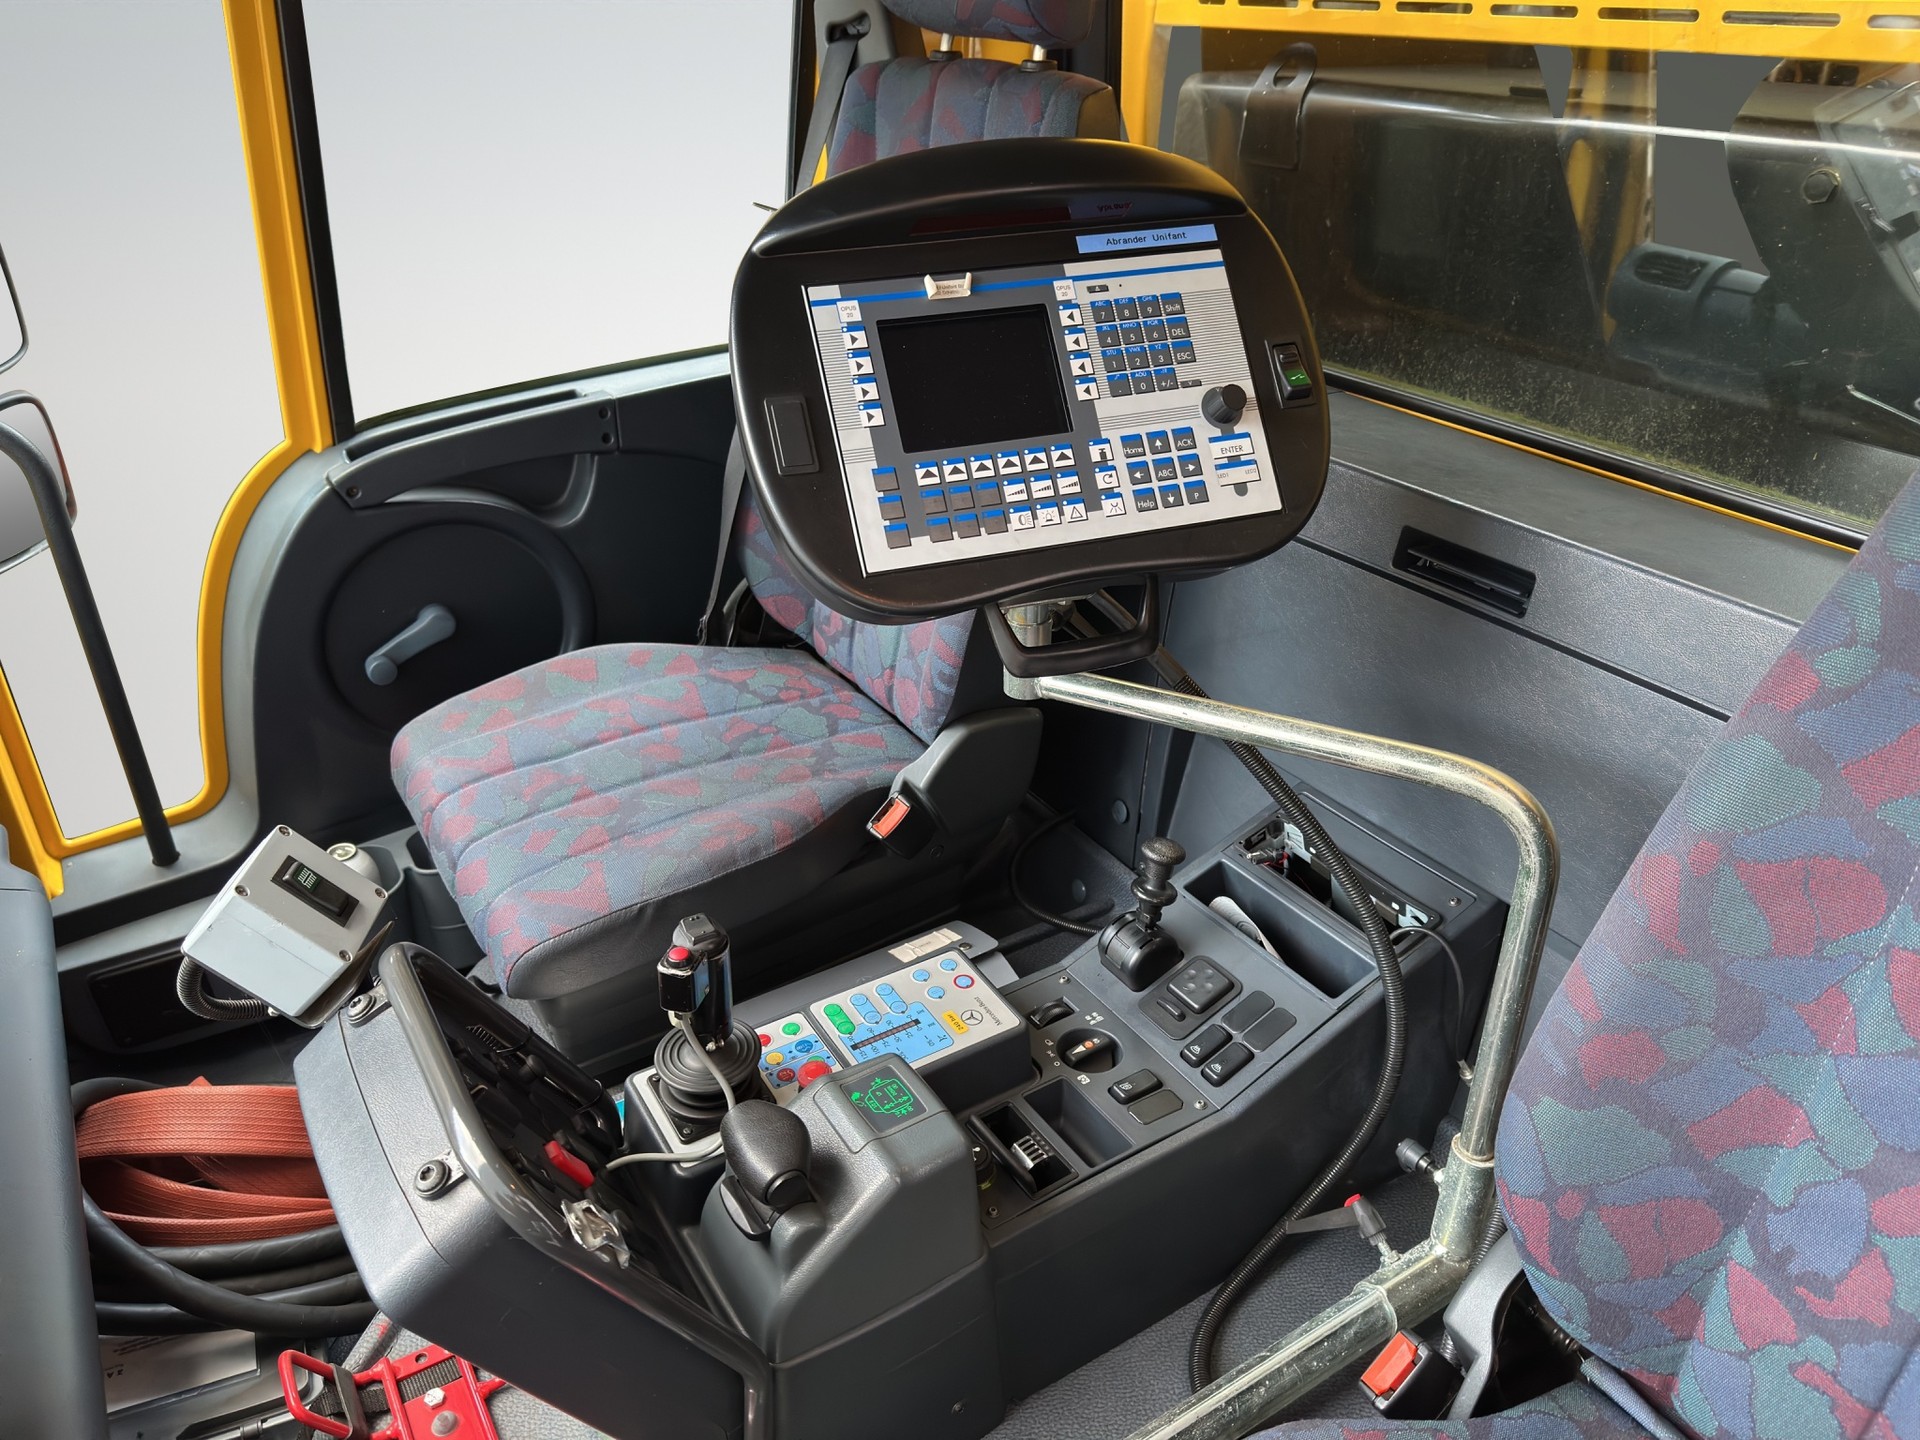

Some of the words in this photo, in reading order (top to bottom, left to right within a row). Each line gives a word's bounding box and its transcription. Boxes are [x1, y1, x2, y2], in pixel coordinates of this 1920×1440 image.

[1106, 235, 1147, 246] Abrander
[1152, 231, 1187, 243] Unifant
[1056, 284, 1071, 292] OPUS
[1147, 306, 1152, 314] 9
[1165, 303, 1181, 312] Shift
[1100, 311, 1106, 320] 7
[1124, 309, 1129, 317] 8
[1153, 331, 1159, 339] 6
[1171, 328, 1186, 337] DEL
[1106, 336, 1112, 344] 4
[1130, 334, 1136, 342] 5
[1158, 355, 1164, 363] 3
[1176, 352, 1192, 361] ESC
[1112, 360, 1117, 368] 1
[1135, 358, 1141, 367] 2
[1140, 382, 1146, 390] 0
[1177, 439, 1194, 448] ACK
[1122, 446, 1144, 455] Home
[1220, 445, 1244, 455] ENTER
[1157, 469, 1174, 478] ABC
[1137, 500, 1155, 509] Help
[946, 1013, 956, 1022] bar
[953, 1021, 964, 1031] 240
